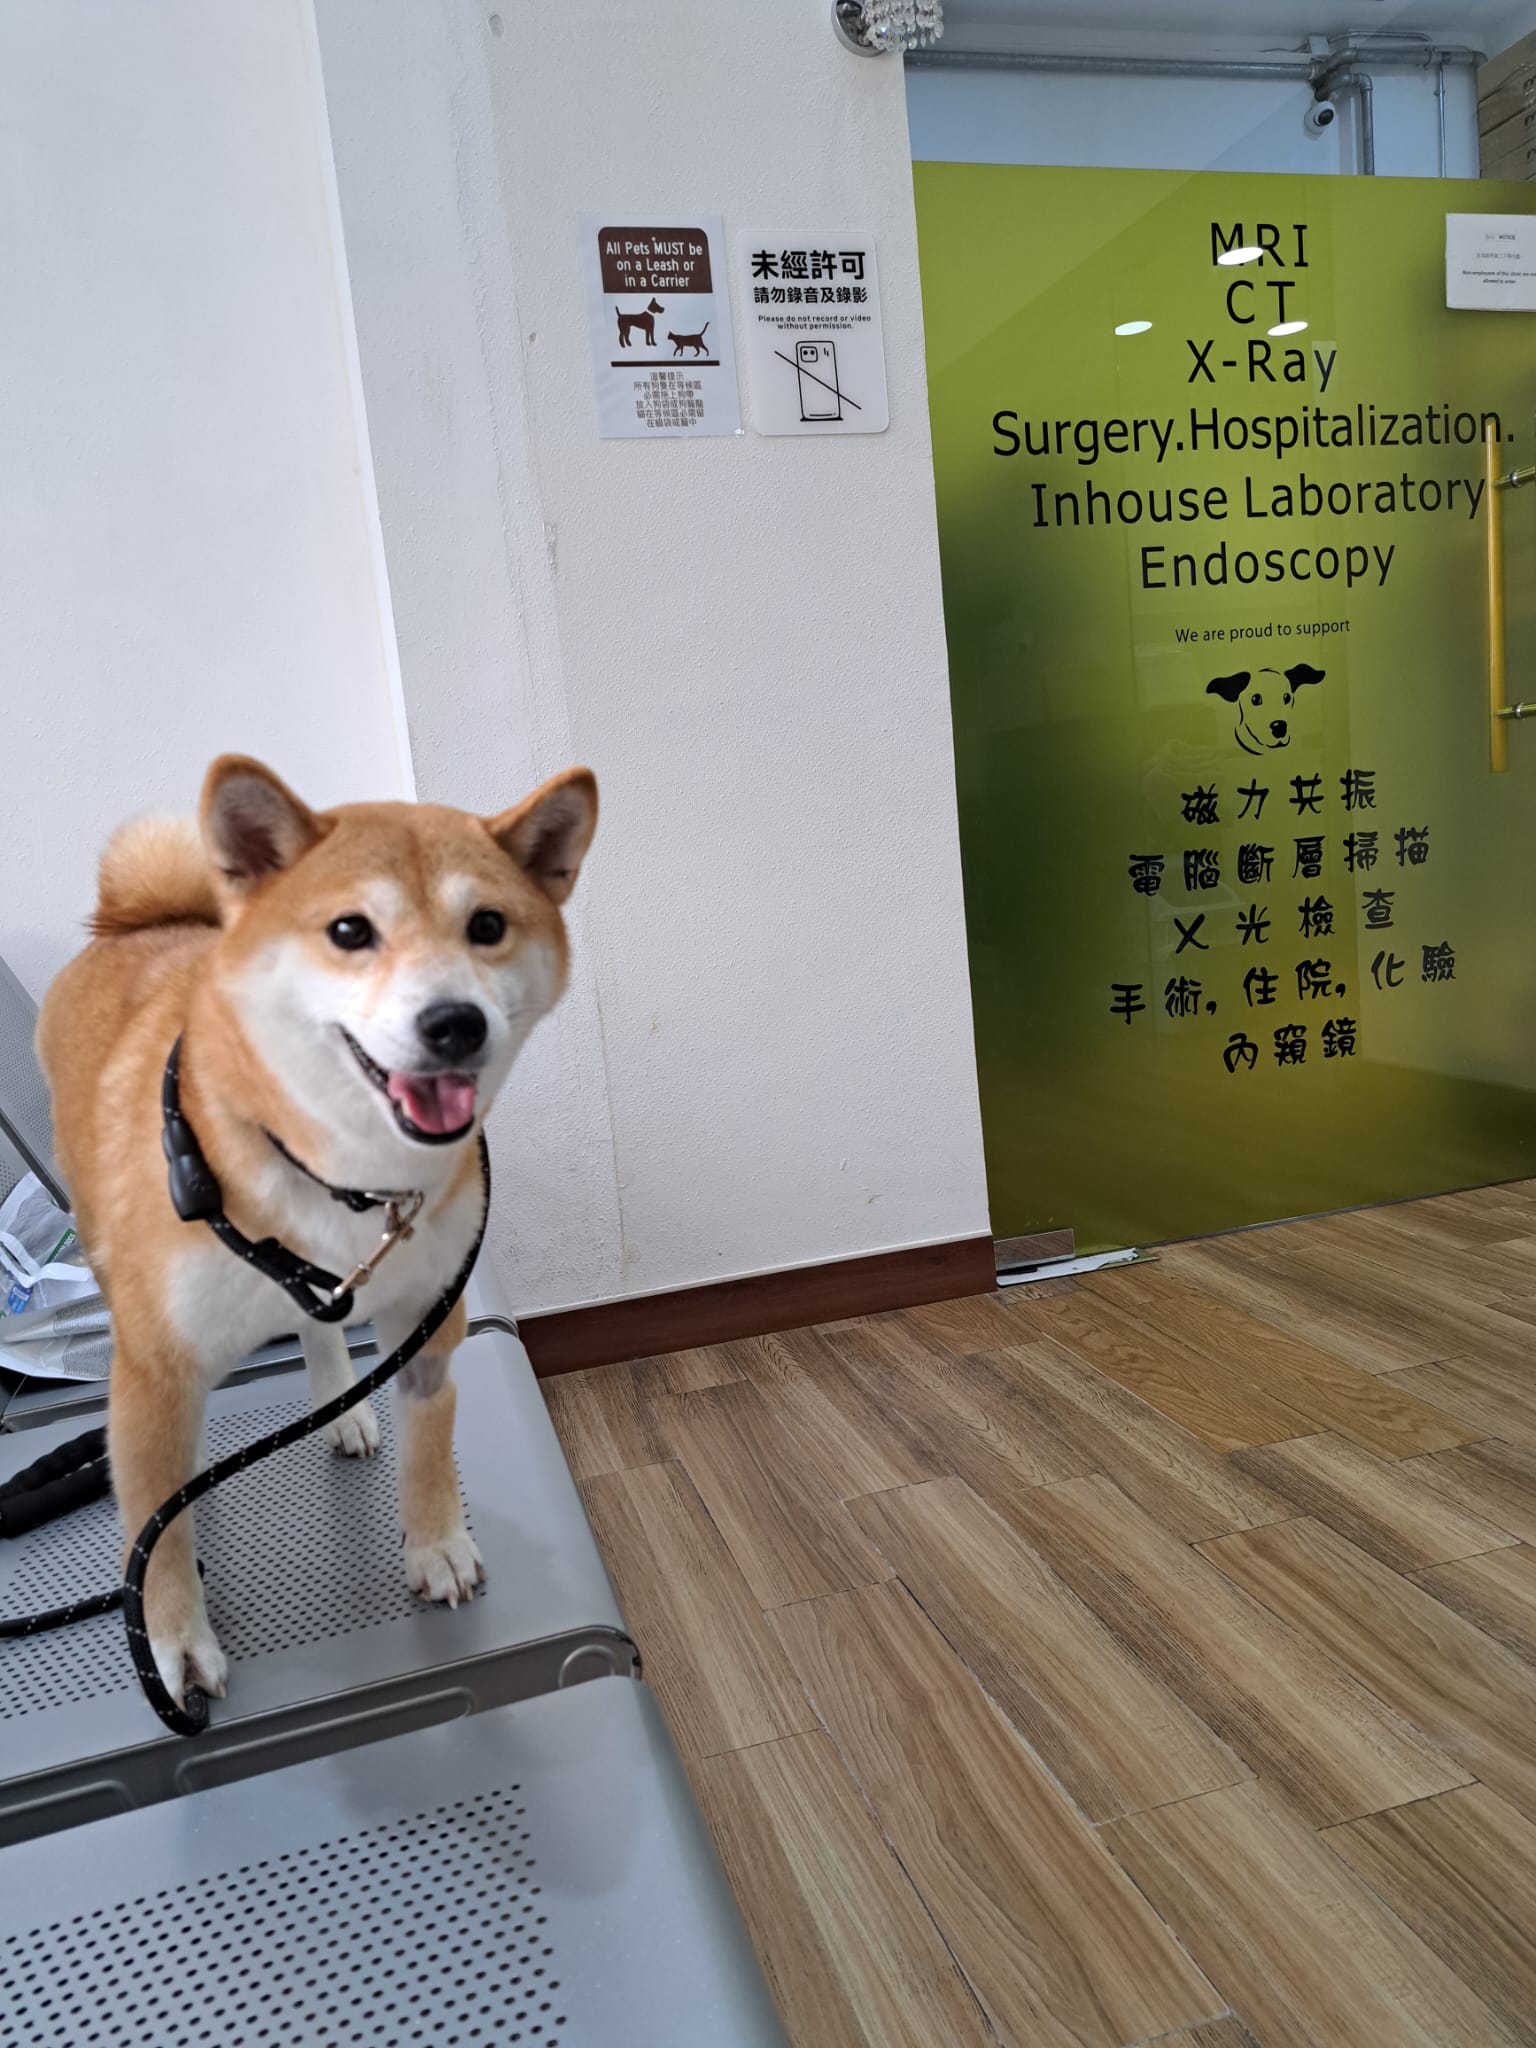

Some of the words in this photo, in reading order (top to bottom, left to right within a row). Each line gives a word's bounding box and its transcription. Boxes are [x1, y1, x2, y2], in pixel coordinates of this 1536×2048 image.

[606, 241, 621, 255] All
[625, 241, 650, 255] Pets
[654, 241, 684, 255] MUST
[689, 242, 703, 256] be
[1210, 222, 1309, 268] MRI
[616, 260, 631, 271] on
[635, 260, 642, 271] a
[646, 258, 679, 271] Leash
[683, 260, 695, 271] or
[751, 249, 867, 280] 未經許可
[624, 275, 636, 287] in
[640, 277, 647, 287] a
[651, 274, 690, 287] Carrier
[753, 286, 868, 304] 請勿錄音及錄影
[1226, 279, 1296, 324] CT
[809, 322, 854, 330] permission.
[1186, 339, 1337, 393] X-Ray
[1031, 480, 1228, 527] Inhouse
[1245, 473, 1485, 520] Laboratory
[1141, 541, 1396, 589] Endoscopy
[1175, 628, 1198, 643] We
[1203, 629, 1225, 641] are
[1230, 622, 1273, 643] proud
[1277, 623, 1292, 636] to
[1296, 619, 1351, 637] support
